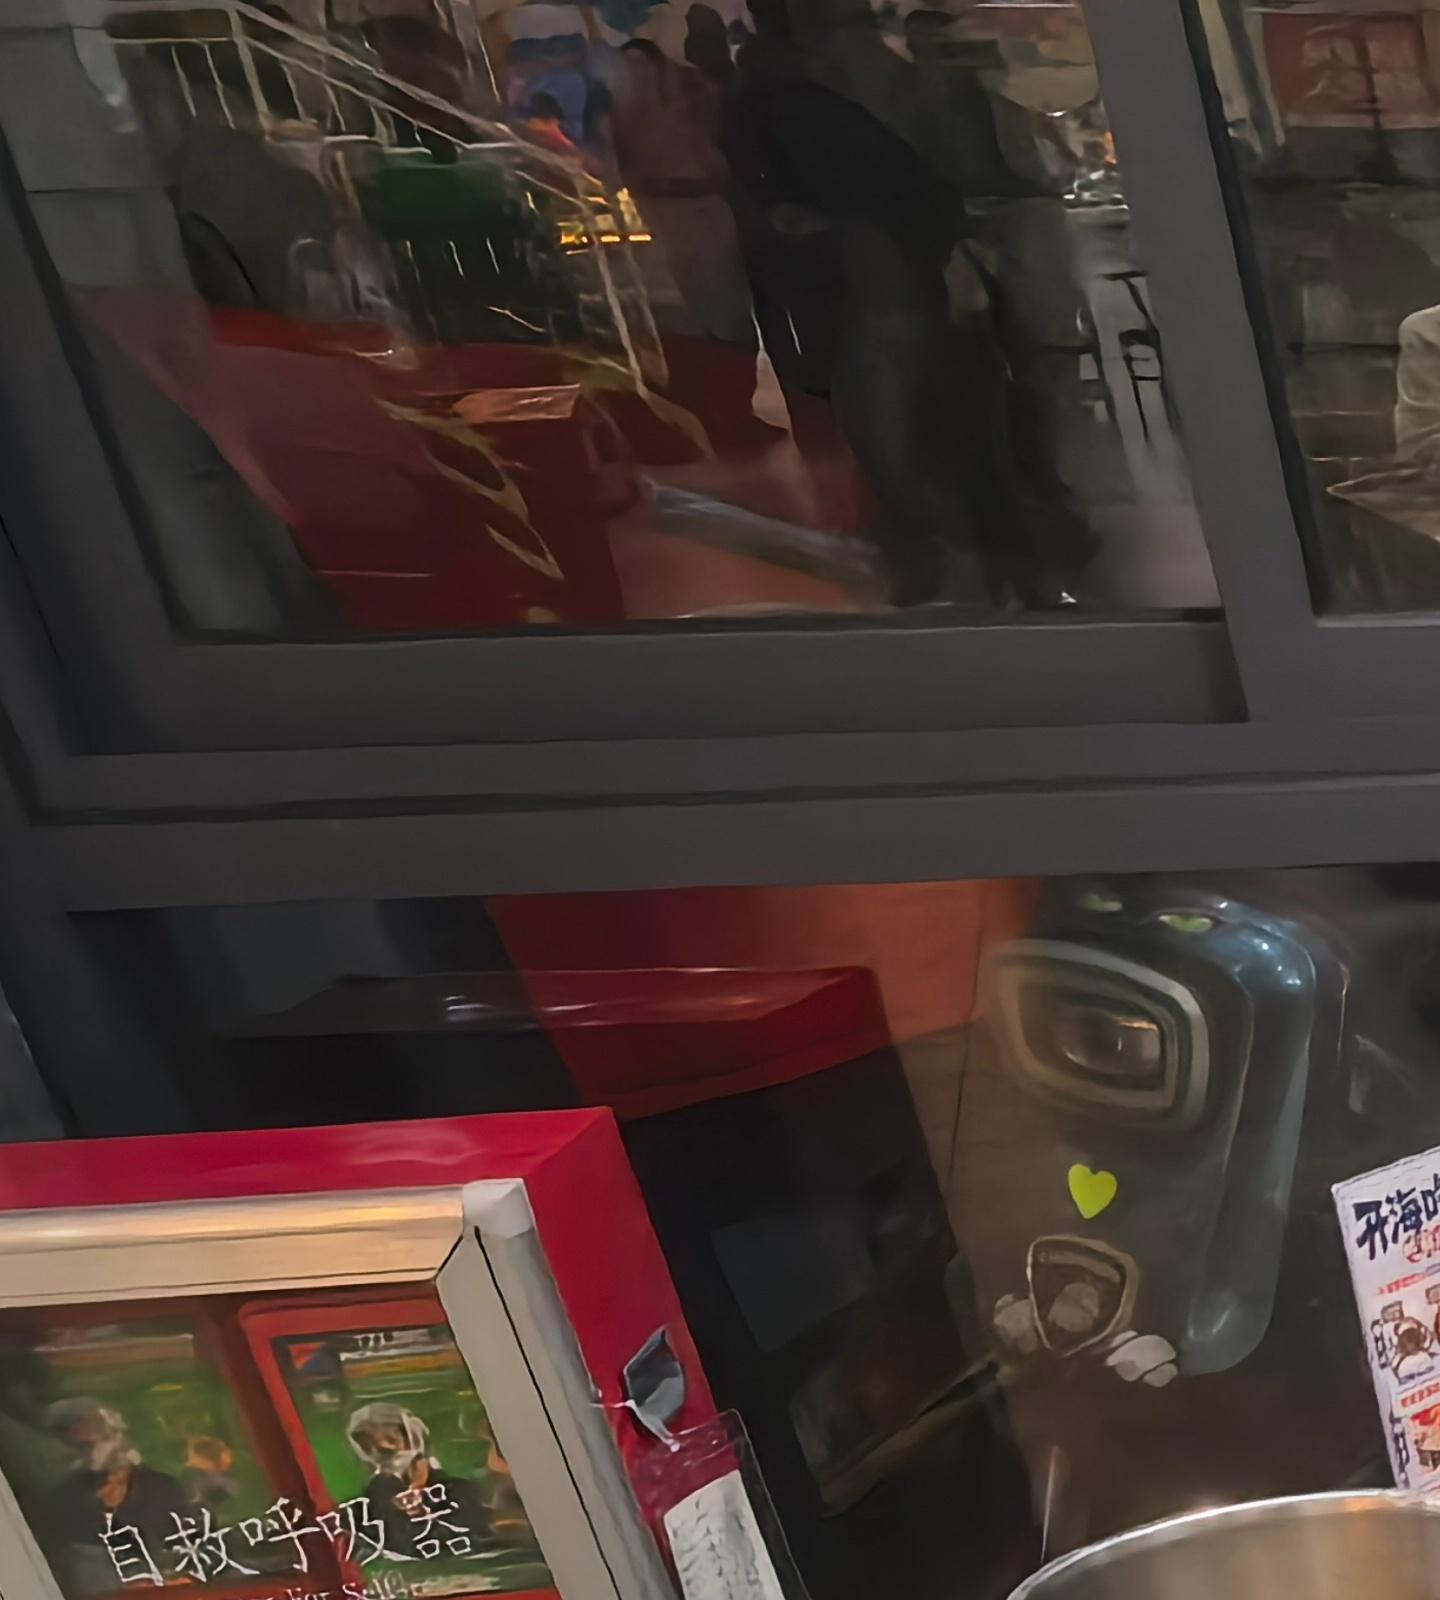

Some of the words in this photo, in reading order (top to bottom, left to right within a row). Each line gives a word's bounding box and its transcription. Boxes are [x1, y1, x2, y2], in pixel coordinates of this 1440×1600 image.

[98, 1483, 472, 1586] 自救呼吸器
